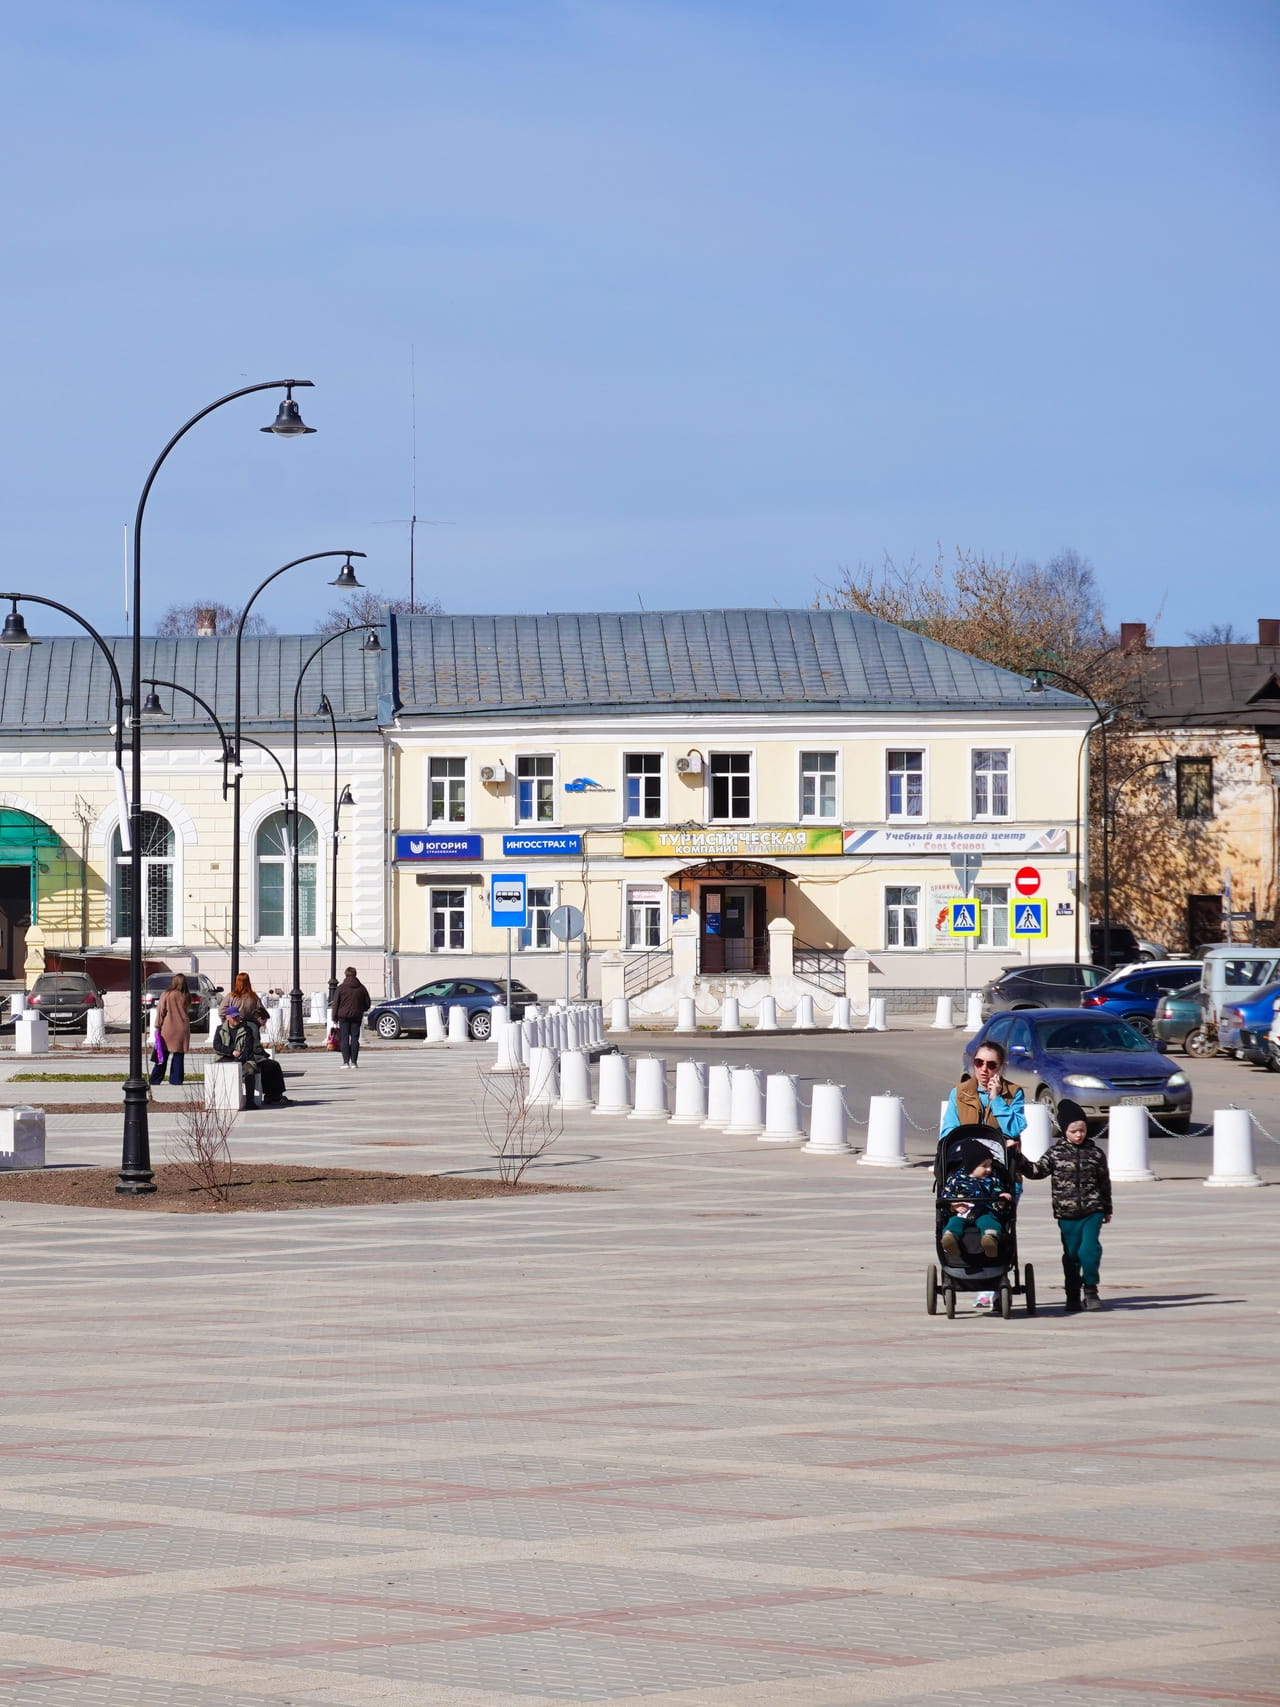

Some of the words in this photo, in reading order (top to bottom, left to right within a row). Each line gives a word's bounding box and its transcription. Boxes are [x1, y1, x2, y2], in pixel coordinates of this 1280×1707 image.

[659, 831, 807, 846] ТУРИСТИЧЕСКАЯ
[885, 831, 932, 841] Учебный
[991, 832, 1027, 842] центр
[426, 841, 468, 850] ЮГОРИЯ
[506, 840, 566, 849] ИНГОССТРАХ
[675, 845, 738, 854] КОМПАНИЯ
